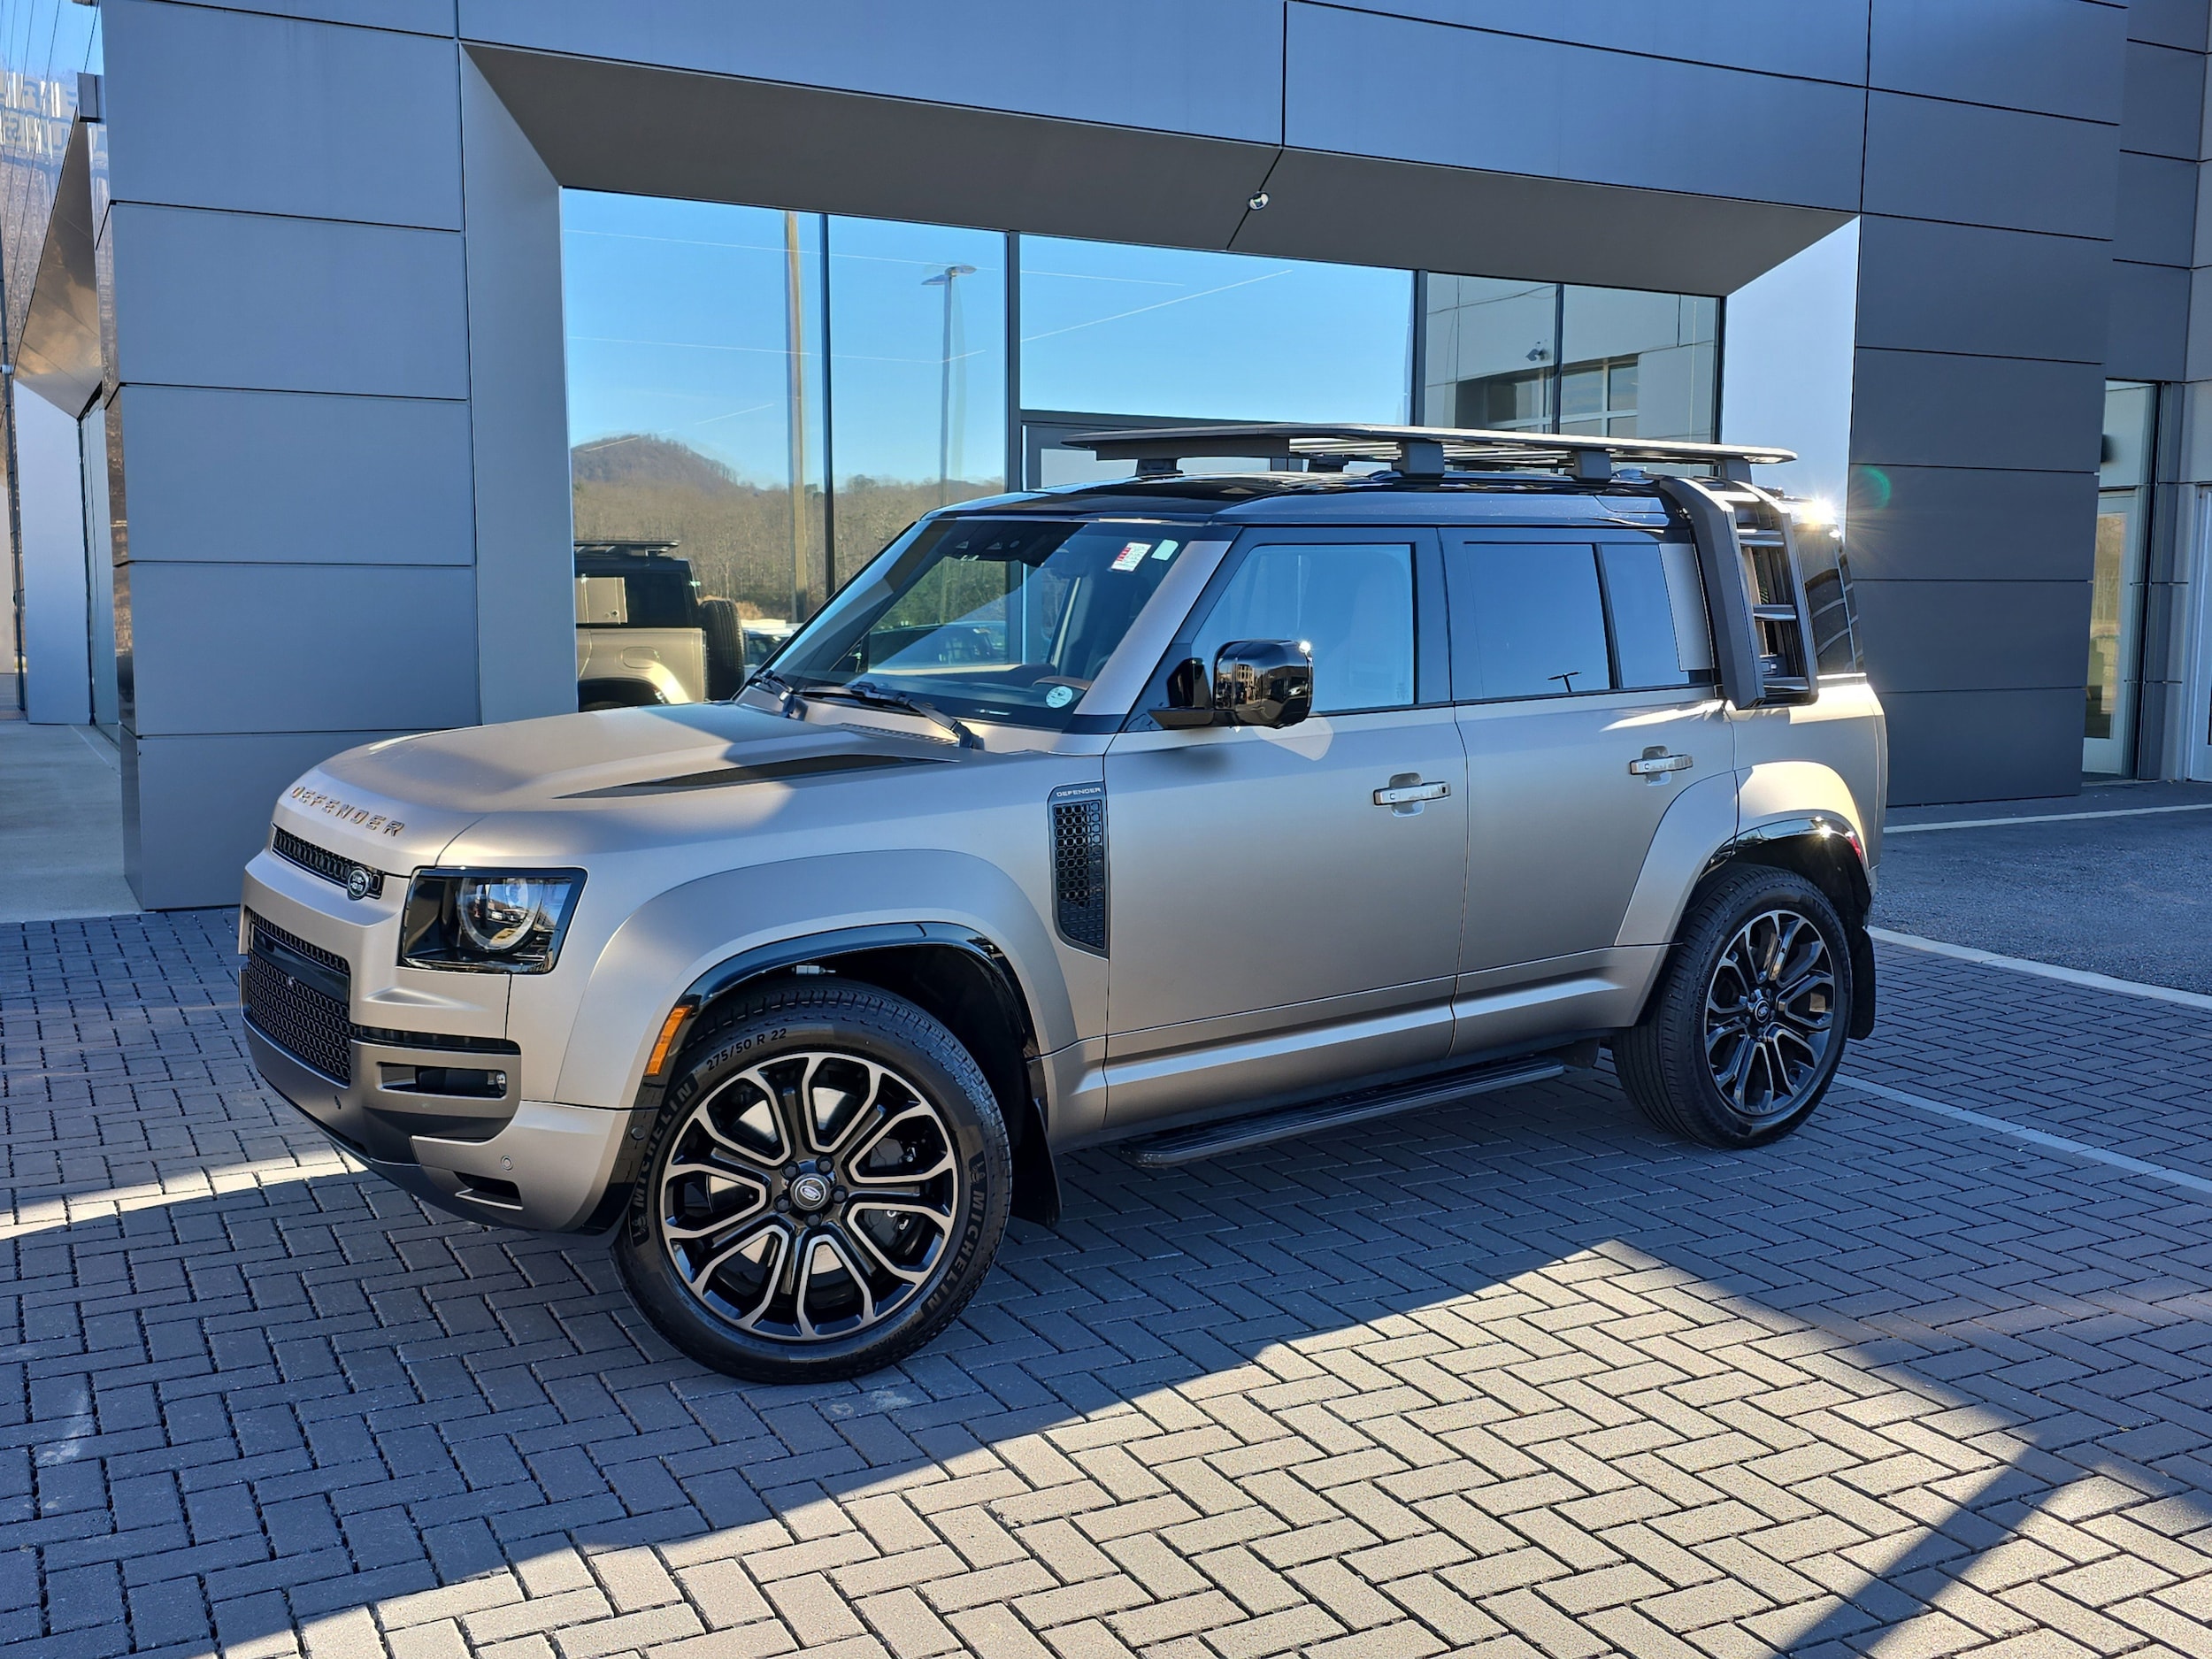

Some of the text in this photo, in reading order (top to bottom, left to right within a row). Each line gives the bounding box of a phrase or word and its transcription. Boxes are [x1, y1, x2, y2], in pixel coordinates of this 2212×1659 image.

[291, 786, 405, 836] DEFENDER
[1056, 787, 1101, 796] DEFENDER
[707, 1028, 787, 1071] 275/50 R 22
[926, 1191, 985, 1311] MICHELIN
